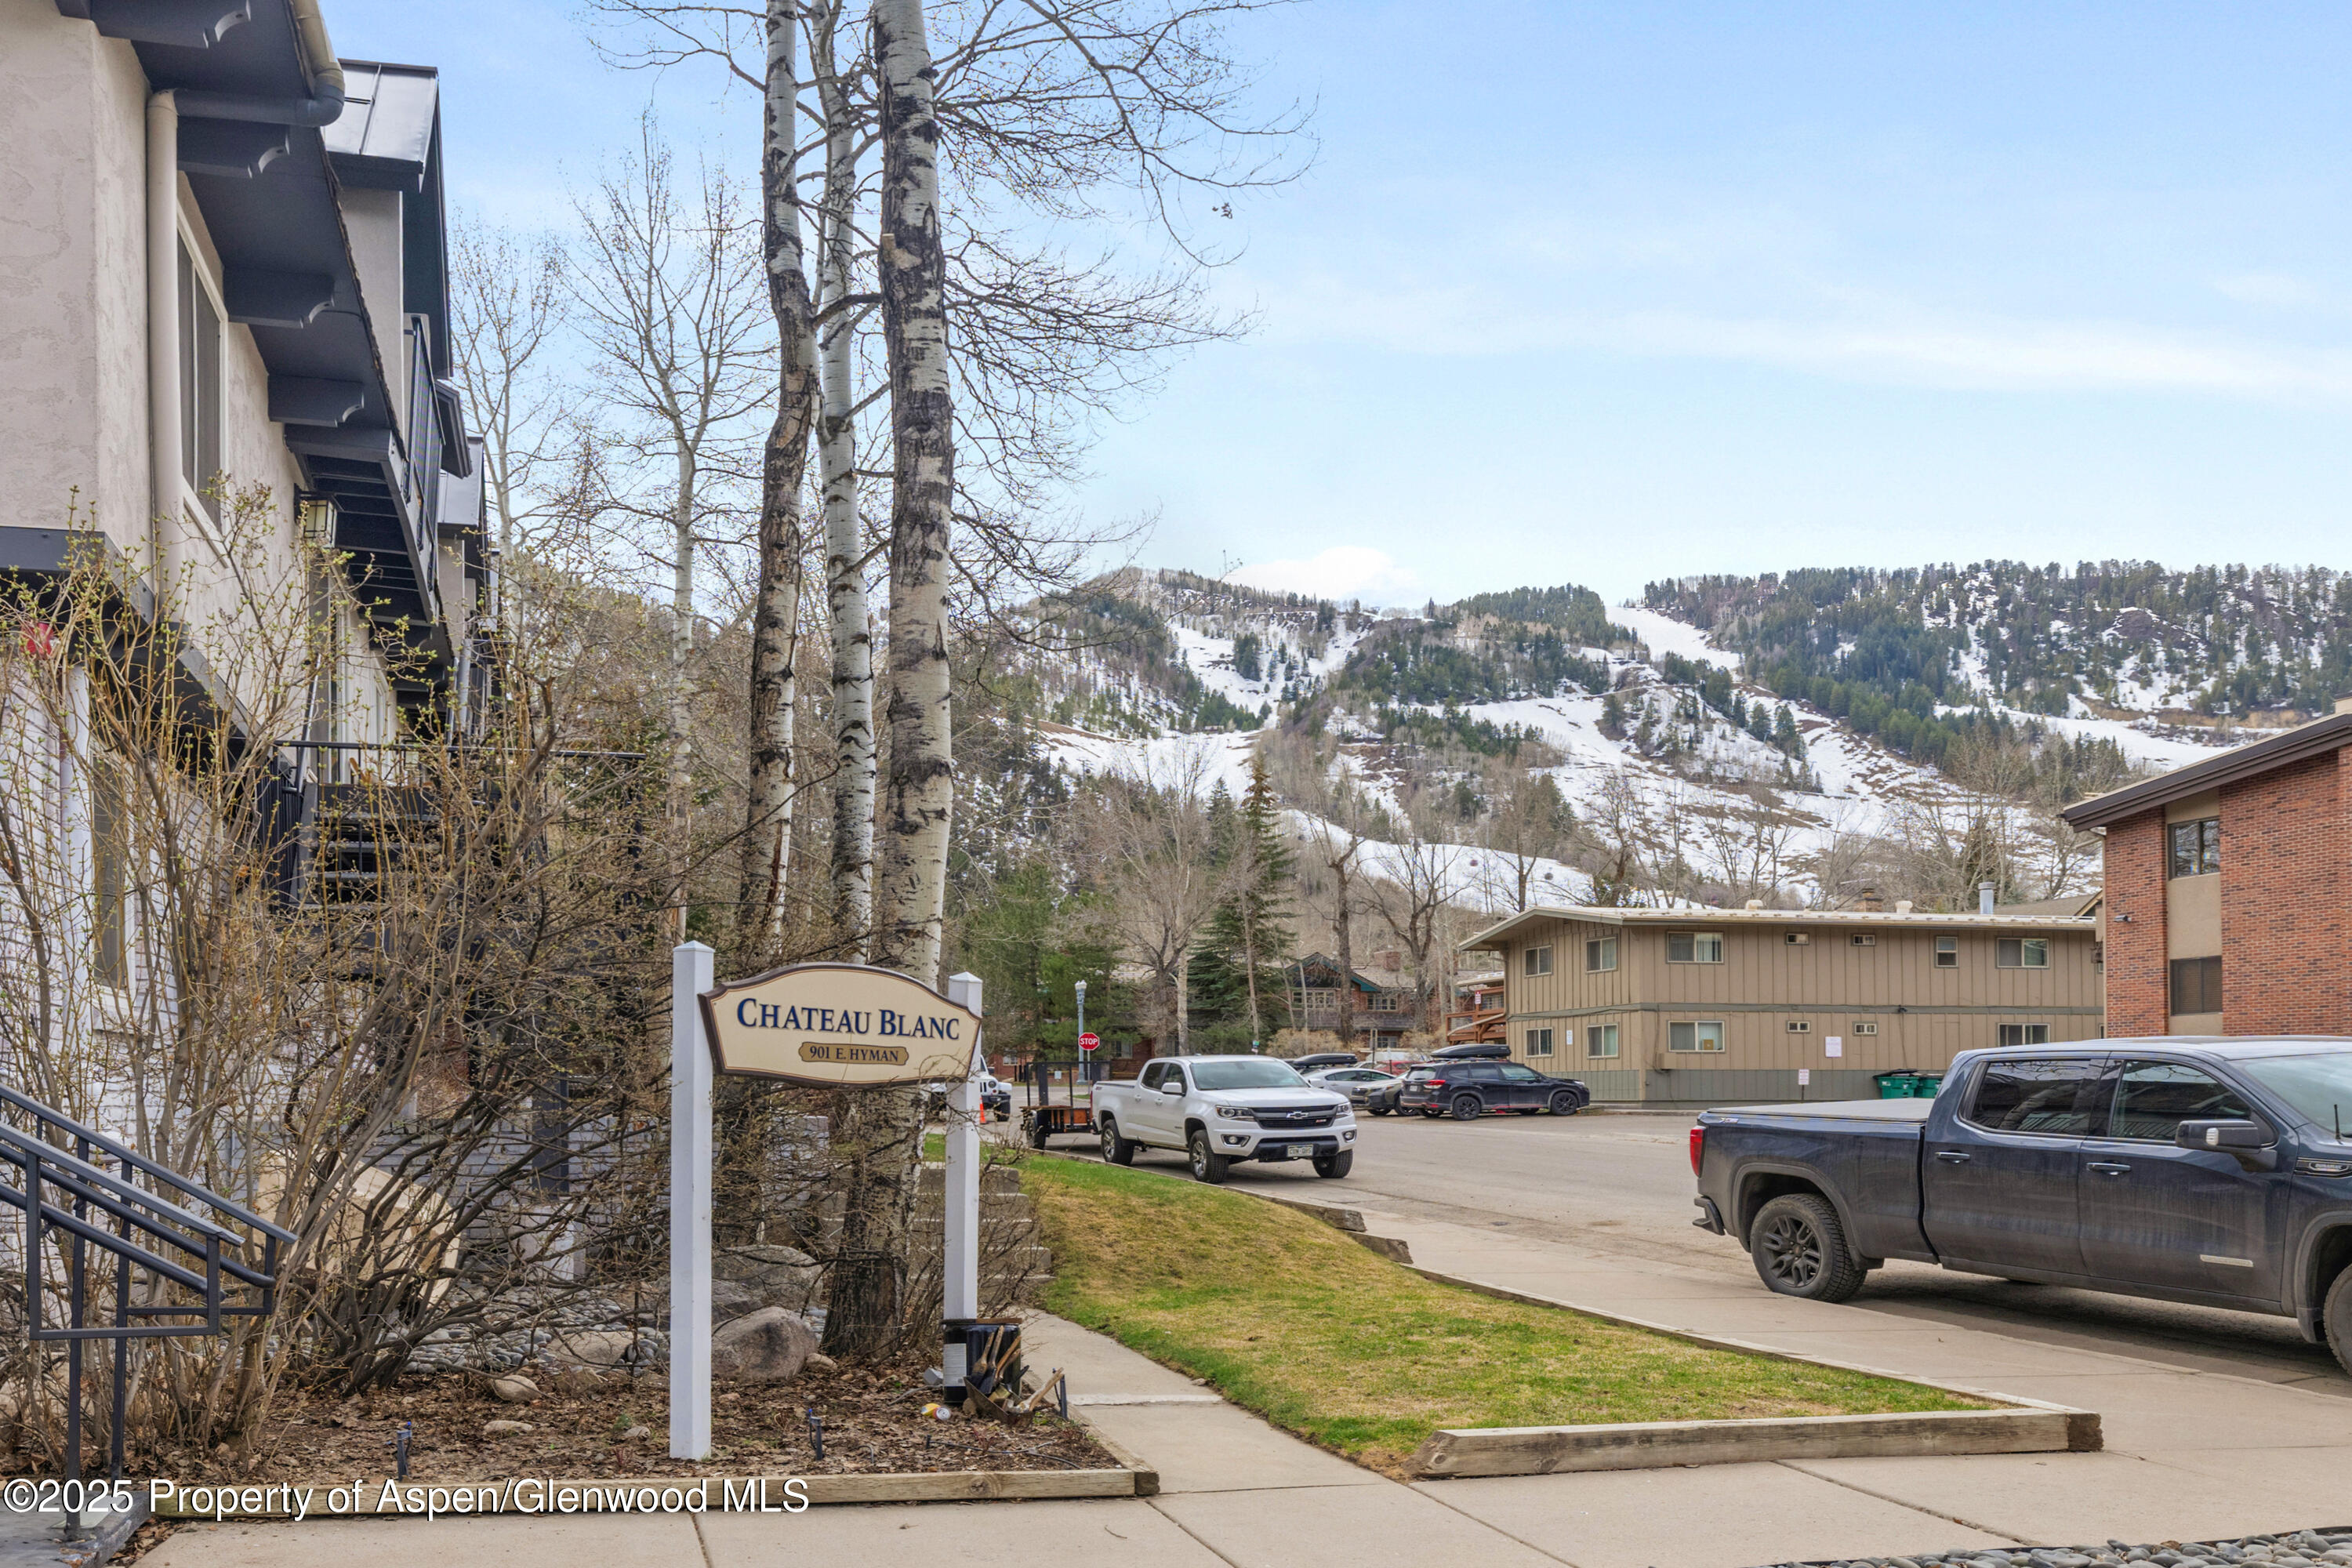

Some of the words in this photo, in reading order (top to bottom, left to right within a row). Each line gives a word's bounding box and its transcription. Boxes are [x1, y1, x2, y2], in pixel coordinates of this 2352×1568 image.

[737, 997, 872, 1034] CHATEAU
[878, 1009, 960, 1040] BLANC
[810, 1046, 830, 1059] 901
[836, 1048, 847, 1060] E.
[849, 1048, 898, 1062] HYMAN
